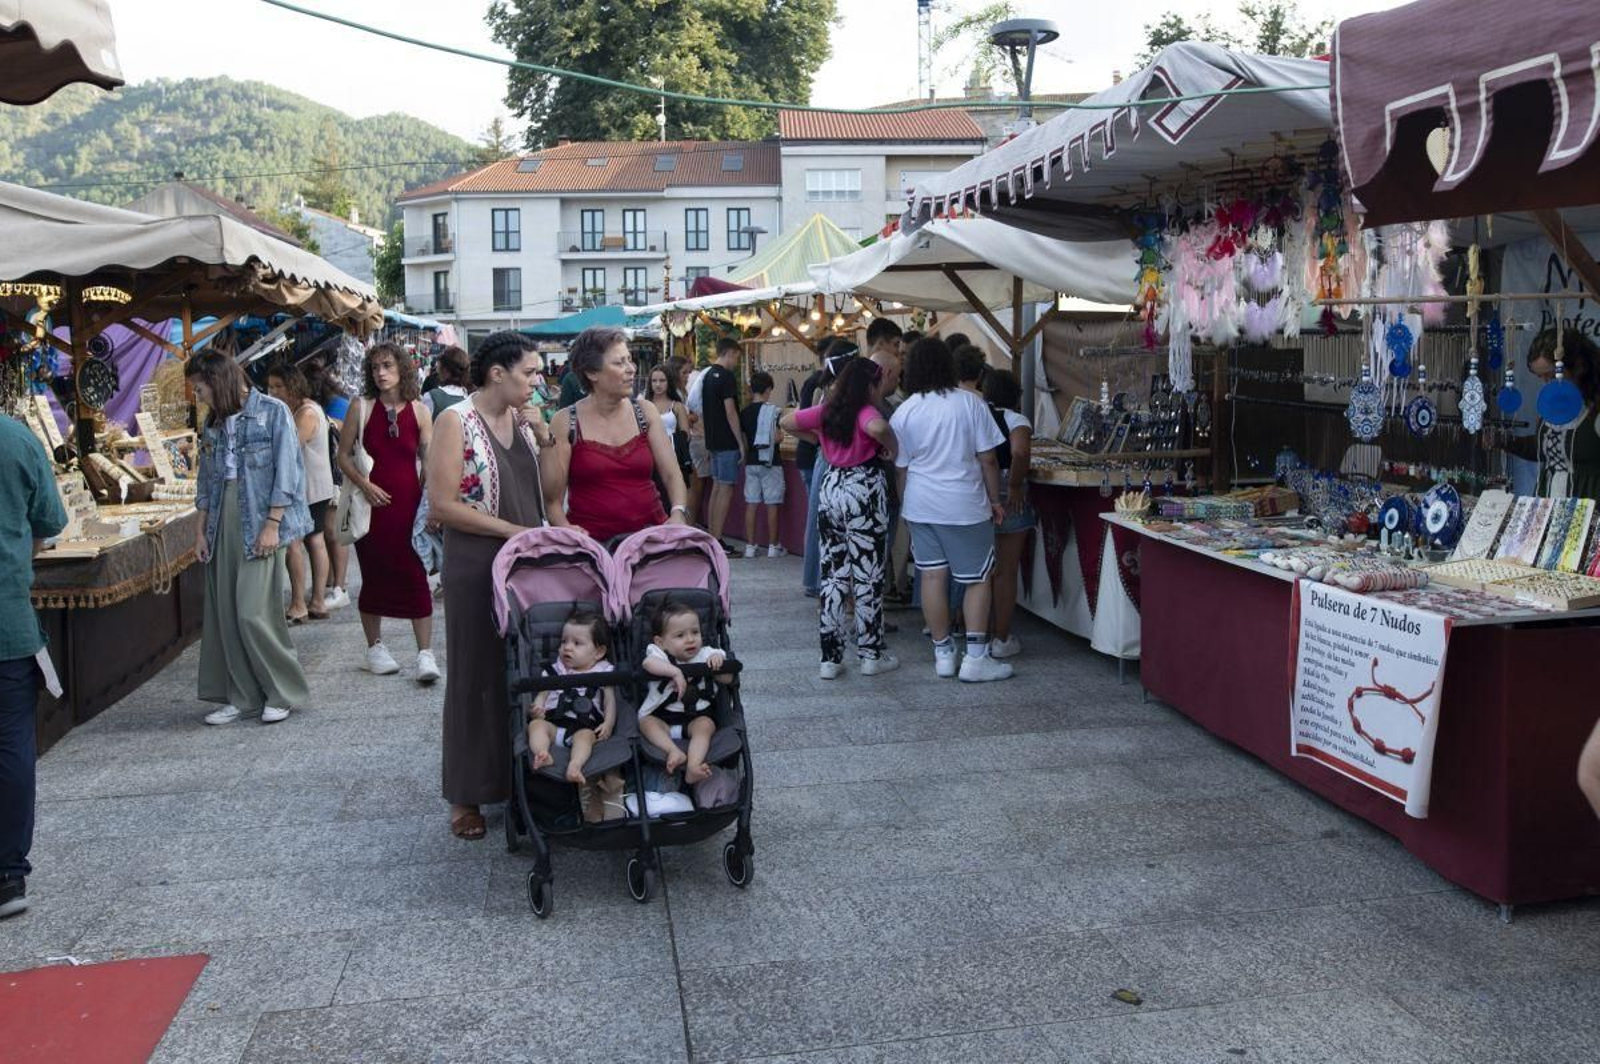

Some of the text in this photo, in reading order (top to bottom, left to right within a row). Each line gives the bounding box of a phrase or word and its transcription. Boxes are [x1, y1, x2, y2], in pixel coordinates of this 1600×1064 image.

[1310, 590, 1421, 636] Pulsera de 7 Nudos
